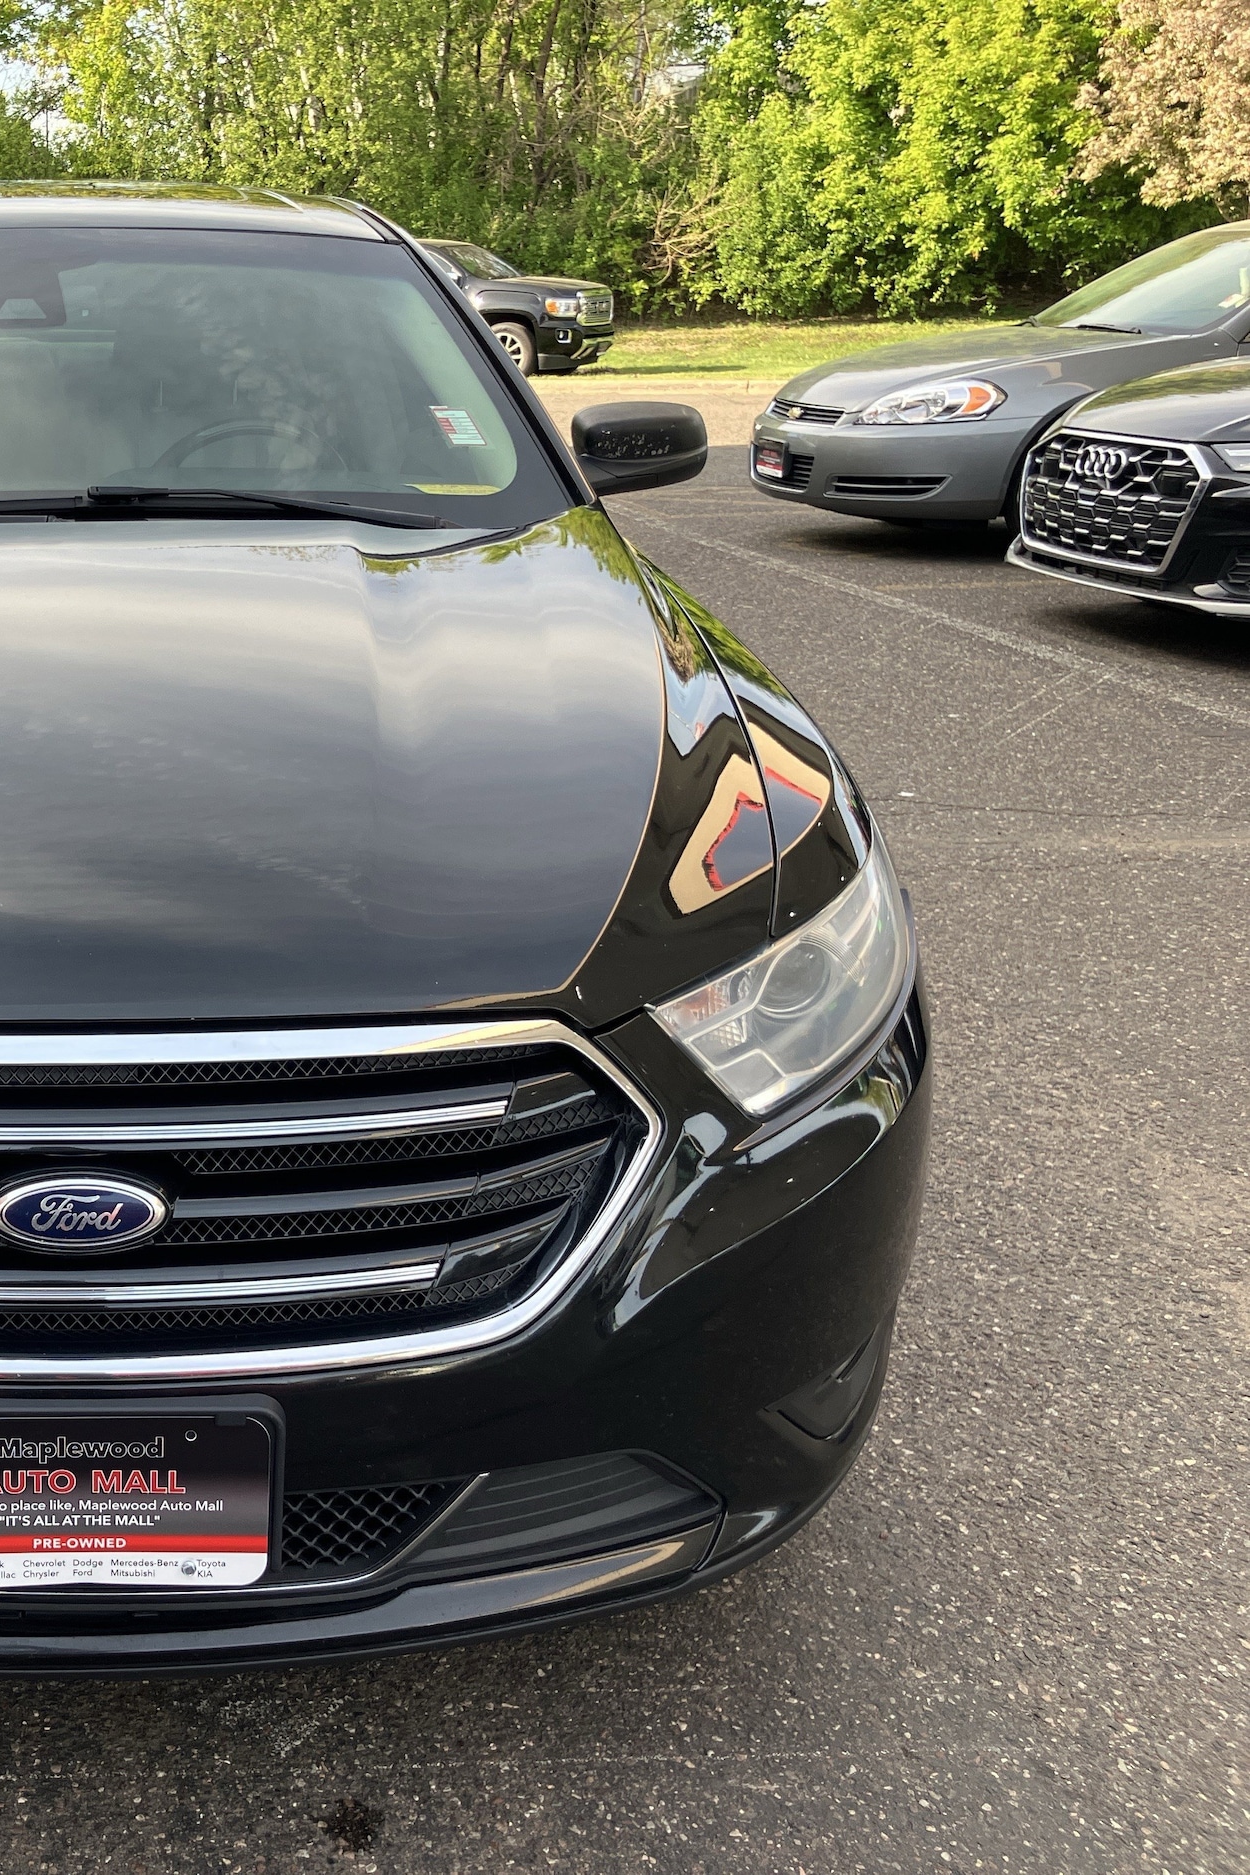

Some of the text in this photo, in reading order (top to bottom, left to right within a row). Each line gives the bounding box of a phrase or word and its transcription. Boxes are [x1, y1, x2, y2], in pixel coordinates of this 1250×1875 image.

[31, 1194, 124, 1232] Ford
[91, 1469, 186, 1495] MALL
[10, 1500, 46, 1514] place
[49, 1500, 76, 1512] like,
[78, 1499, 157, 1513] Maplewood
[160, 1500, 192, 1511] Auto
[195, 1500, 224, 1512] Mall
[0, 1514, 161, 1527] "IT'S ALL AT THE MALL"
[33, 1537, 127, 1549] PRE-OWNED
[22, 1559, 66, 1568] Chevrolet
[72, 1559, 103, 1568] Dodge
[110, 1558, 179, 1567] Mercedes-Benz
[197, 1559, 226, 1568] Toyota
[22, 1569, 60, 1579] Chrysler
[110, 1568, 156, 1577] Mitsubishi
[197, 1570, 213, 1578] KIA
